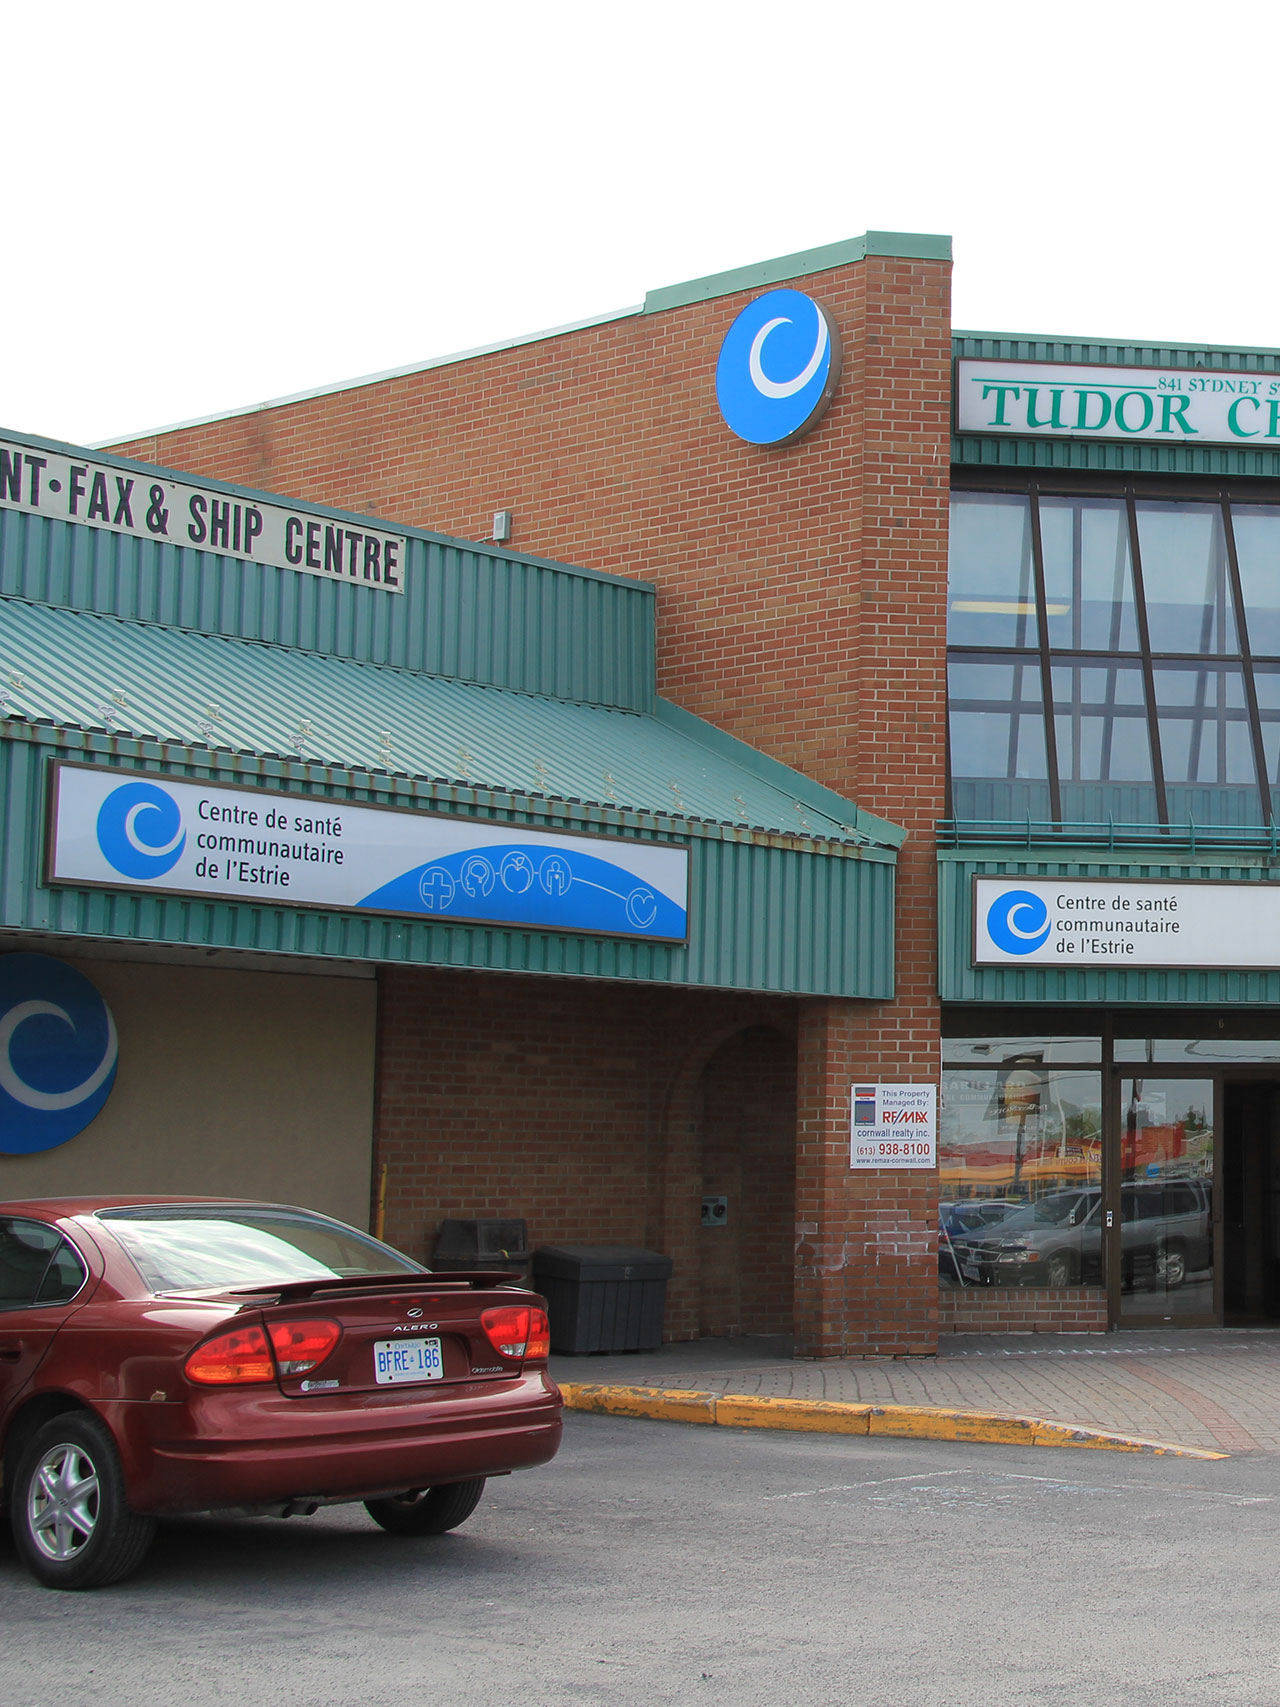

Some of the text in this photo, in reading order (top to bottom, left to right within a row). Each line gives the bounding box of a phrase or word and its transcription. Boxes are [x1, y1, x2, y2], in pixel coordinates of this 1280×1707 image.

[1158, 377, 1182, 391] 841
[1188, 378, 1262, 394] SYDNEY
[982, 385, 1199, 434] TUDOR
[146, 484, 169, 536] &
[188, 494, 263, 554] SHIP
[285, 516, 399, 586] CENTRE
[198, 800, 342, 837] Centre de santé
[197, 833, 344, 865] communautaire
[195, 857, 219, 878] de
[1056, 895, 1178, 911] Centre de santé
[1056, 918, 1180, 933] communautaire
[1056, 938, 1075, 953] de
[882, 1109, 928, 1125] RE/MAX
[857, 1129, 930, 1139] cornwall realty inc.
[857, 1143, 930, 1156] (613) 938-8100
[393, 1324, 438, 1332] ALERO
[378, 1348, 440, 1373] BFRE 186
